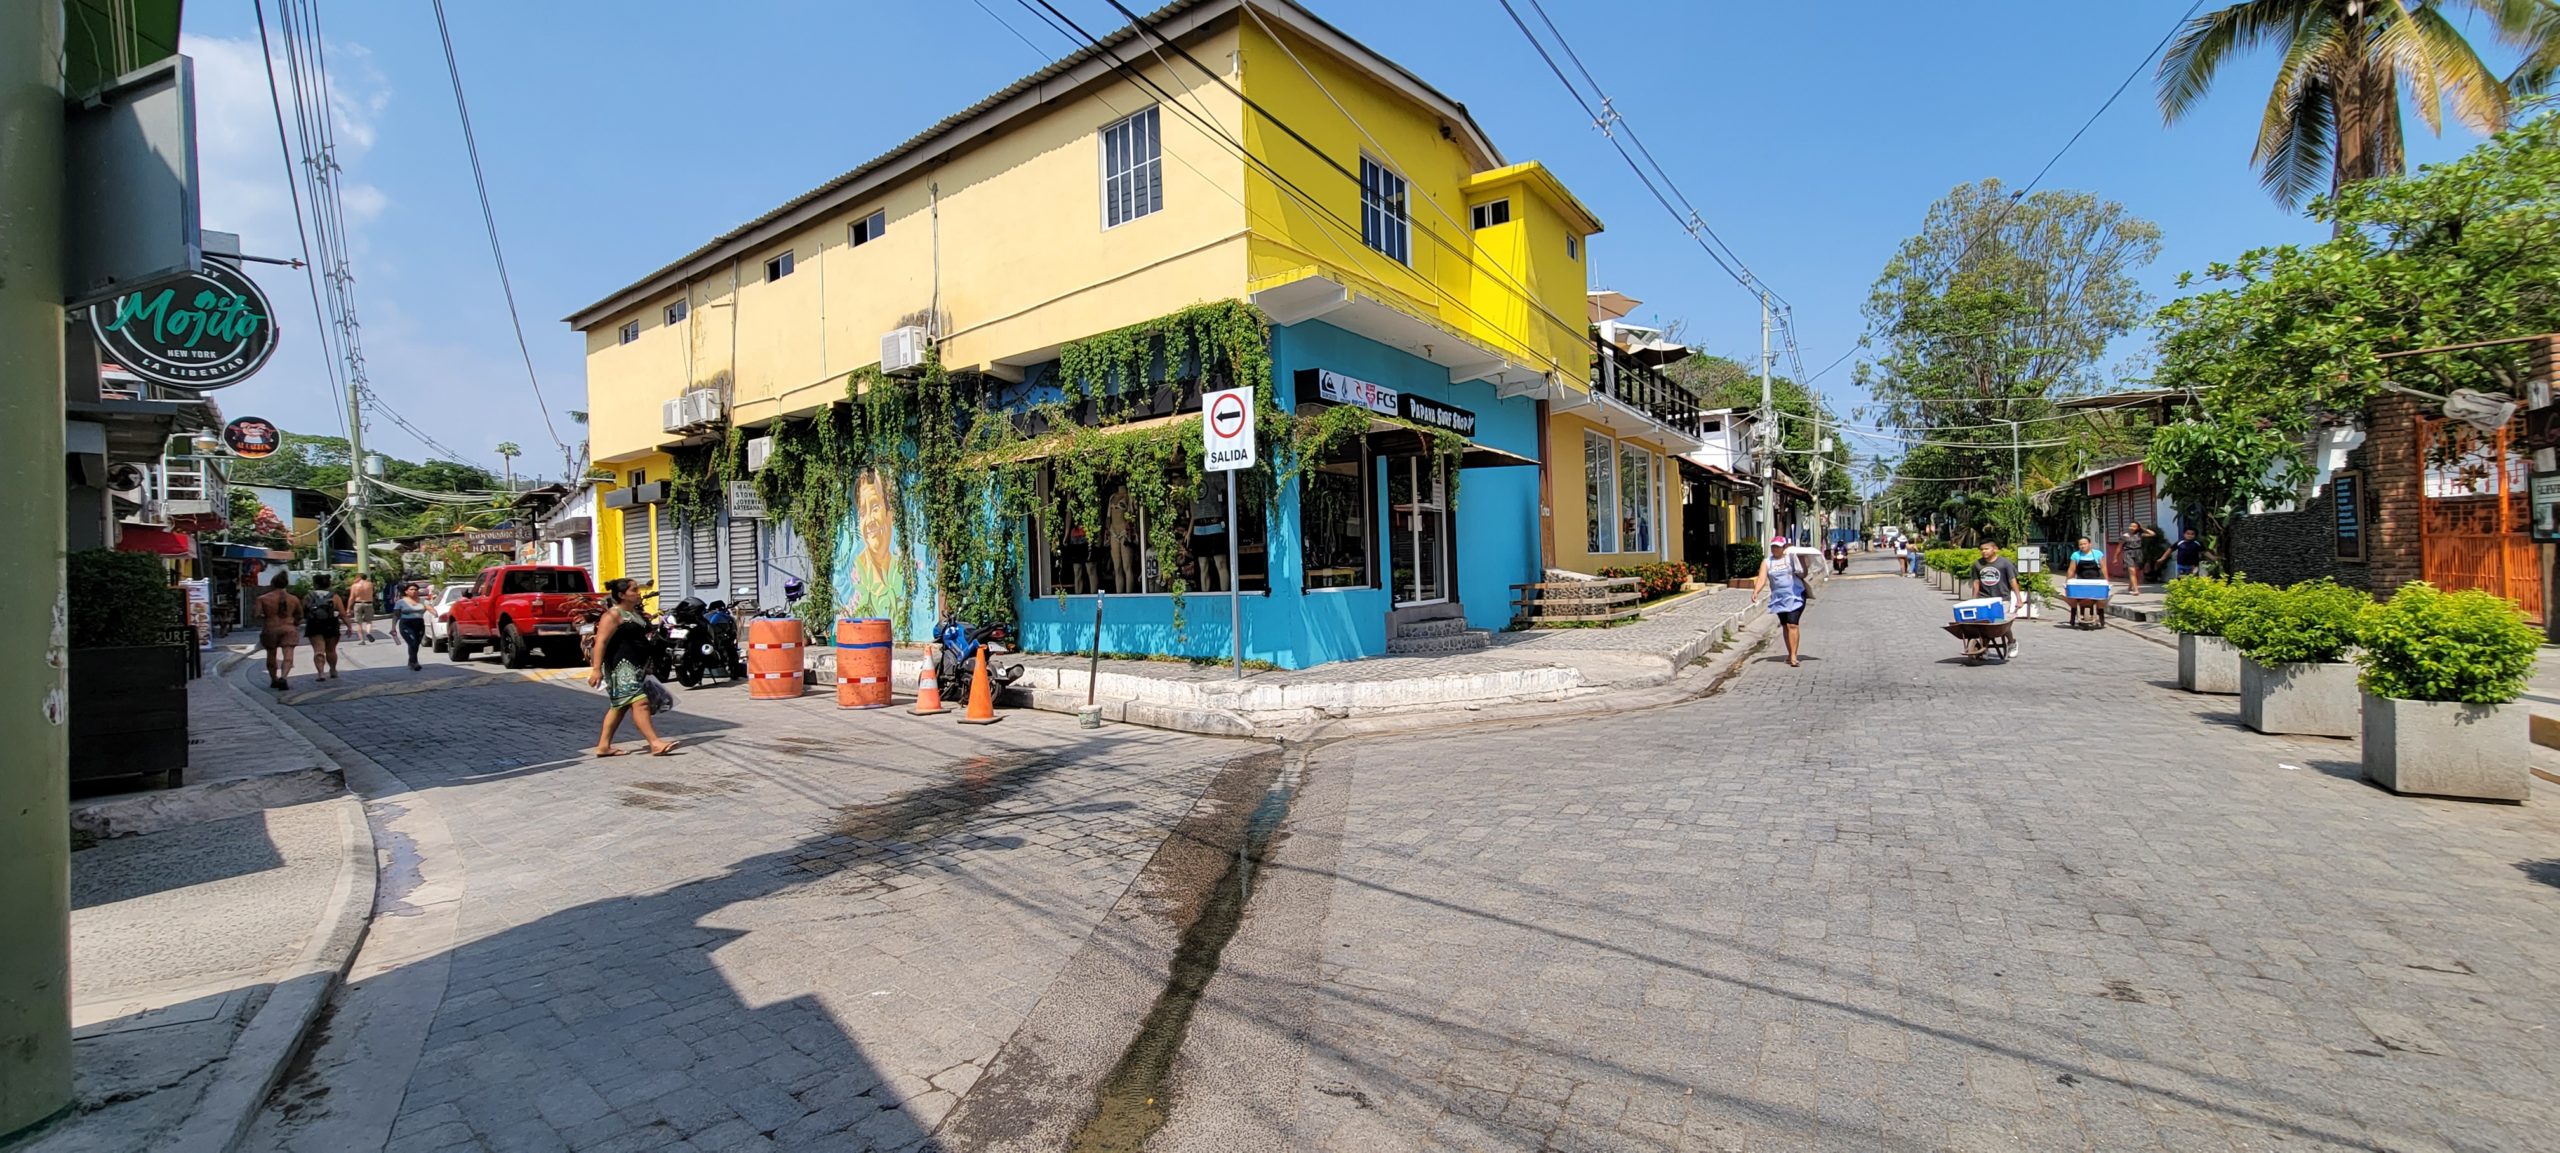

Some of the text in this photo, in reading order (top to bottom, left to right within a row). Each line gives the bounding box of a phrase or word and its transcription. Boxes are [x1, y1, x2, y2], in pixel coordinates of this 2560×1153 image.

[105, 288, 267, 348] Mojito
[167, 349, 217, 359] NEW YORK
[141, 357, 245, 377] LA LIBERTAD
[1376, 391, 1396, 409] FCS
[1409, 398, 1468, 431] PAPAYA SURF SHOP
[1211, 448, 1248, 464] SALIDA
